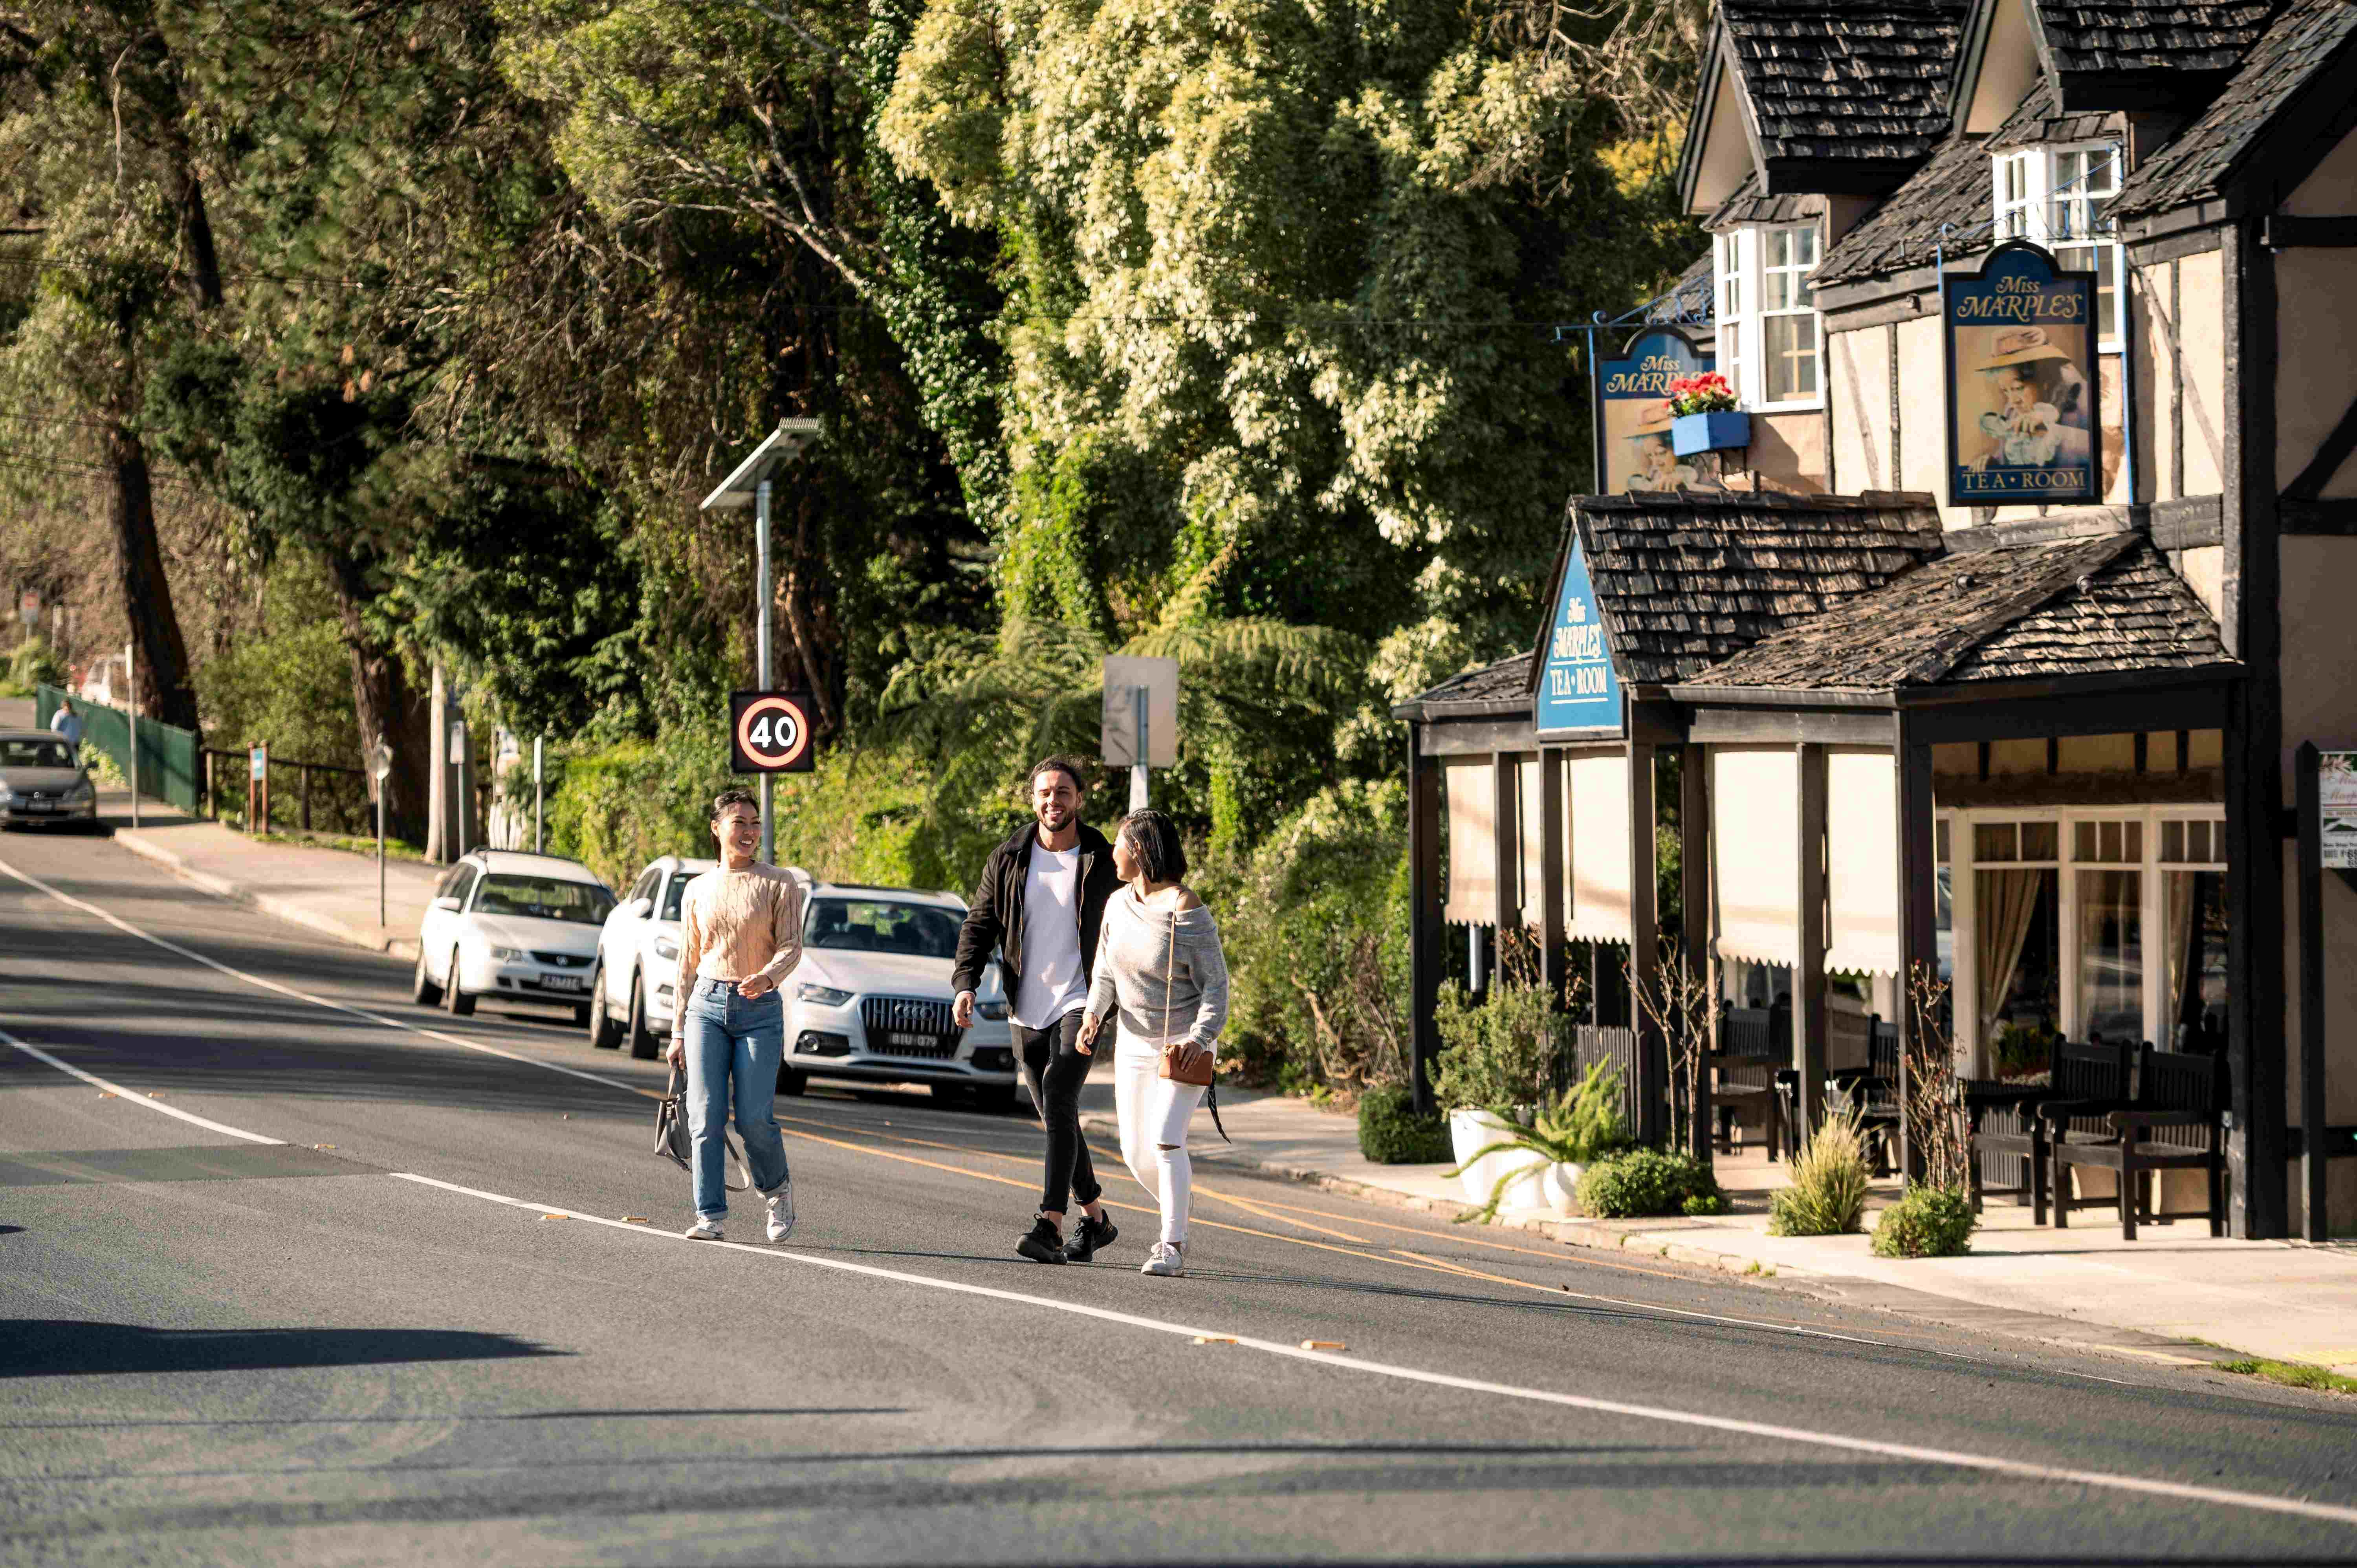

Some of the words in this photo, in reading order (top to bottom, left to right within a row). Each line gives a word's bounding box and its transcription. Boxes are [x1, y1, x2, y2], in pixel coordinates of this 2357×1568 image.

[1995, 276, 2040, 294] Miss
[1640, 355, 1680, 371] Miss
[1962, 472, 2007, 489] TEA
[2020, 471, 2086, 488] ROOM
[1550, 669, 1572, 696] TEA
[1576, 667, 1607, 694] ROOM
[749, 716, 797, 748] 40
